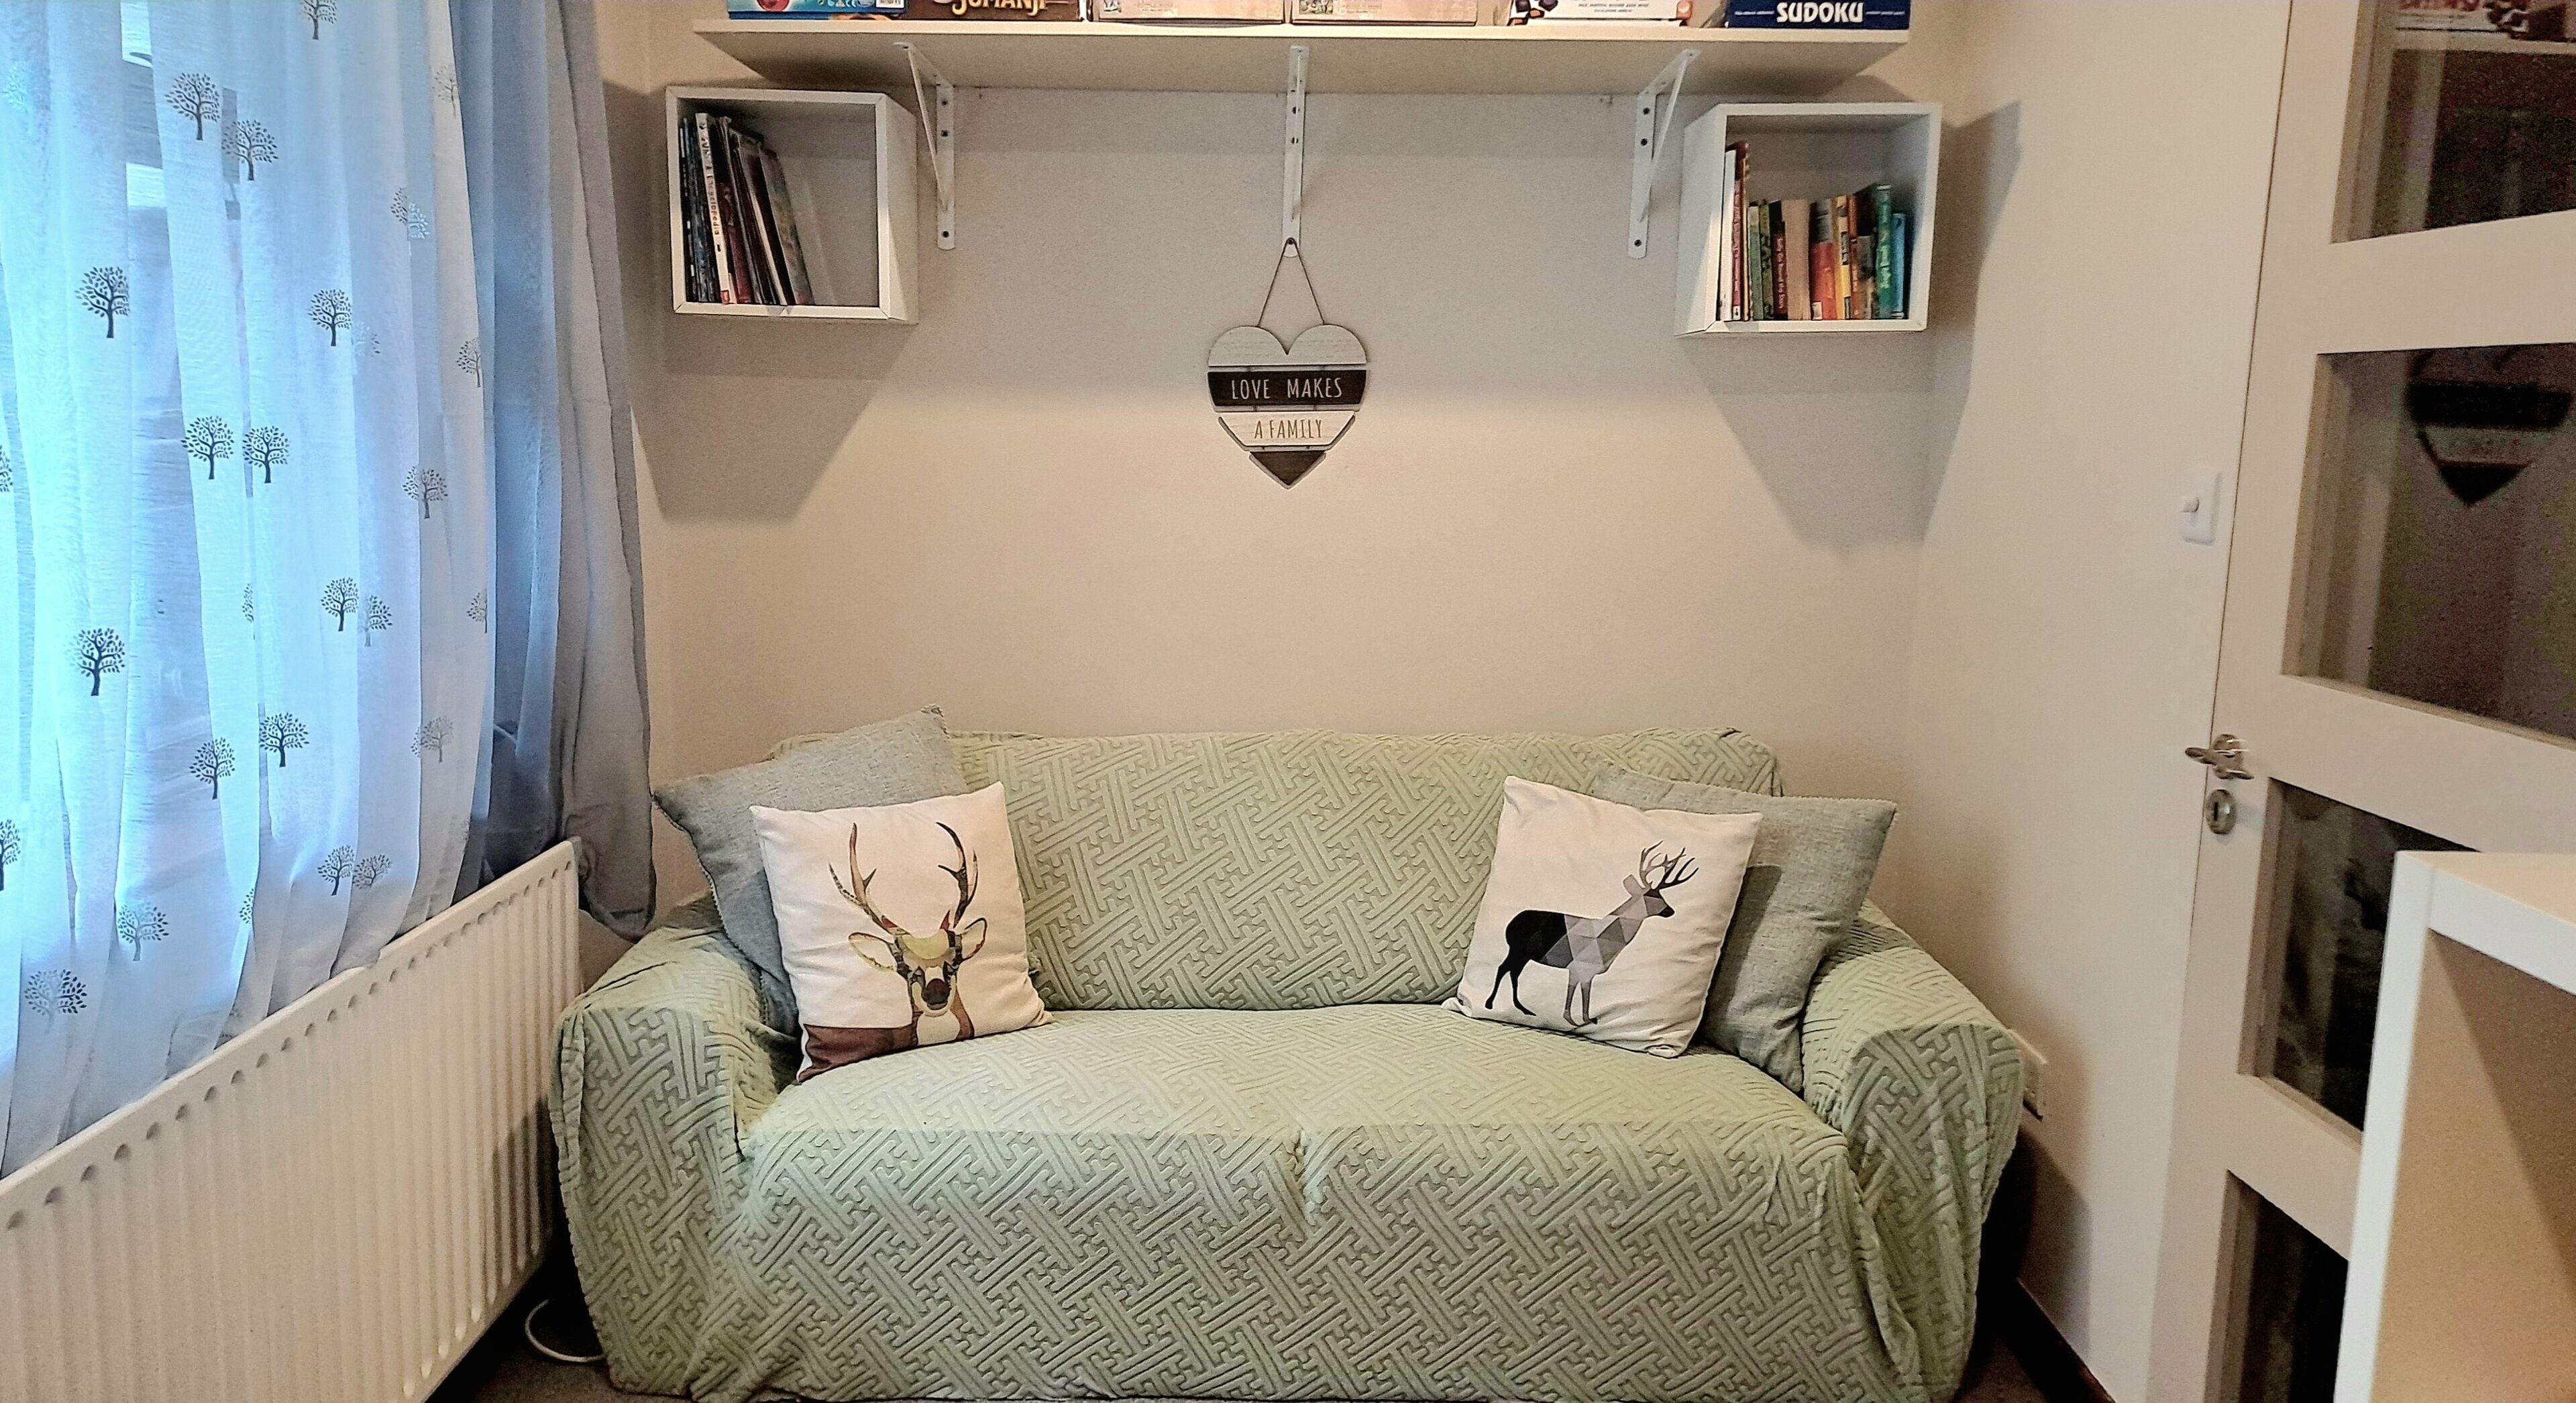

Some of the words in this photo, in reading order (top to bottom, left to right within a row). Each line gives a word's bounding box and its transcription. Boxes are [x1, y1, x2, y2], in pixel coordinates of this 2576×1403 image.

[1776, 2, 1864, 23] SUDOKU
[1232, 379, 1271, 399] LOVE
[1287, 378, 1342, 399] MAKES
[1254, 420, 1263, 439] A
[1269, 419, 1322, 439] FAMILY
